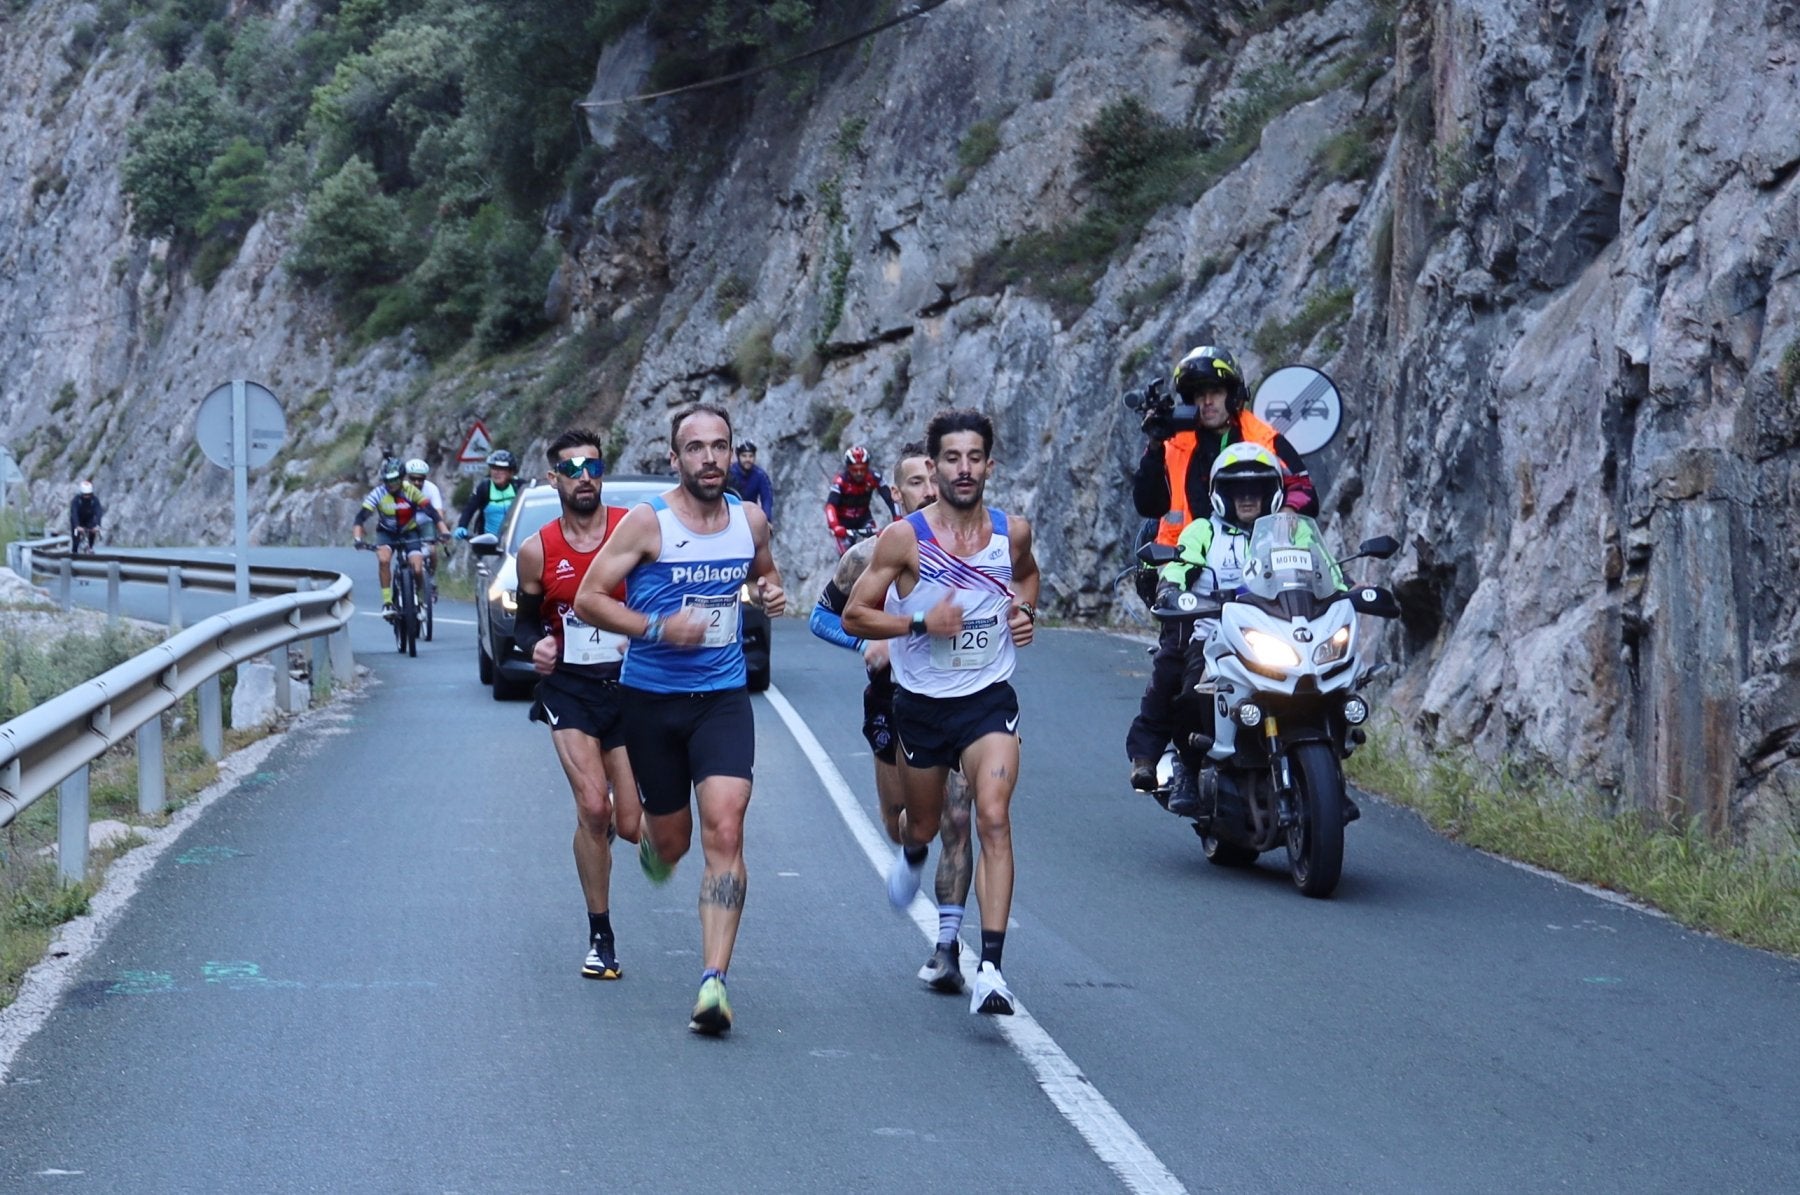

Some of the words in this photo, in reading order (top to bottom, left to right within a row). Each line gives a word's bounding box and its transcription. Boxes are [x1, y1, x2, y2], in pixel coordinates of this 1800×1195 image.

[1276, 555, 1298, 565] MOTO
[1300, 556, 1308, 565] TV
[1365, 591, 1374, 599] TV
[1181, 598, 1195, 606] TV
[709, 609, 721, 628] 2
[589, 627, 602, 645] 4
[949, 630, 988, 651] 126
[1295, 629, 1313, 641] TV
